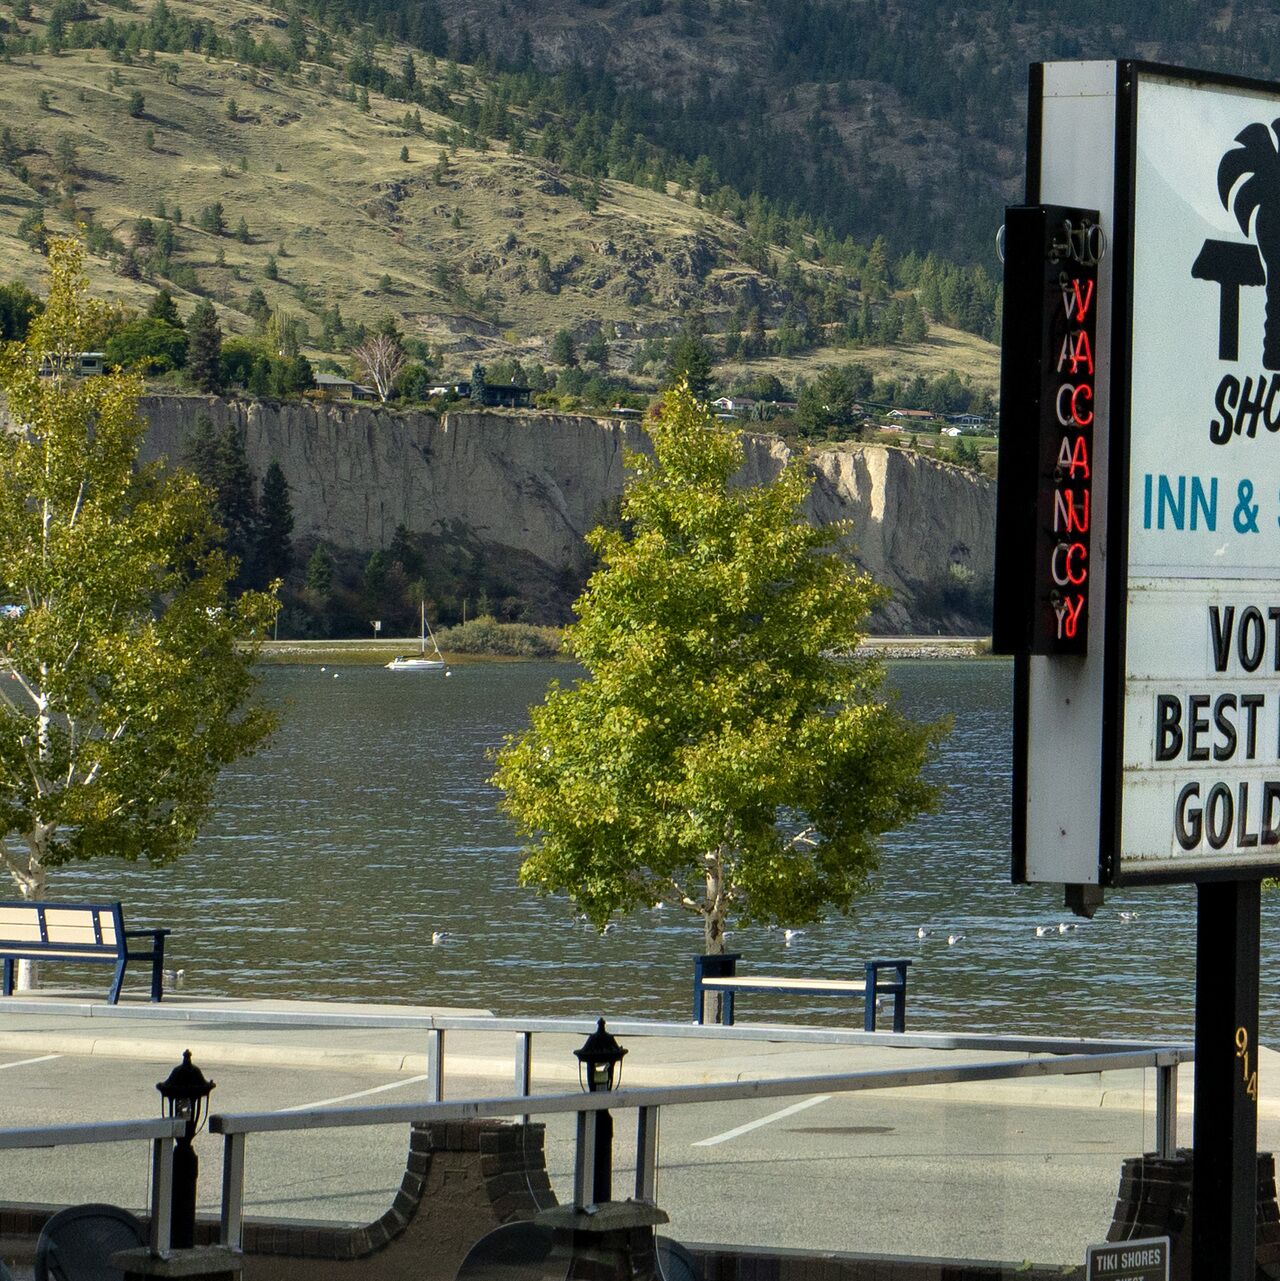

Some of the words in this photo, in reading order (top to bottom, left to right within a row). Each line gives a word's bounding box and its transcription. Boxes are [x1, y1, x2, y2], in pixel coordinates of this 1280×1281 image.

[1062, 278, 1094, 639] VACANCY
[1142, 473, 1219, 532] INN
[1232, 478, 1260, 534] &
[1155, 693, 1265, 762] BEST
[1096, 1254, 1118, 1271] TIKI
[1121, 1248, 1161, 1269] SHORES
